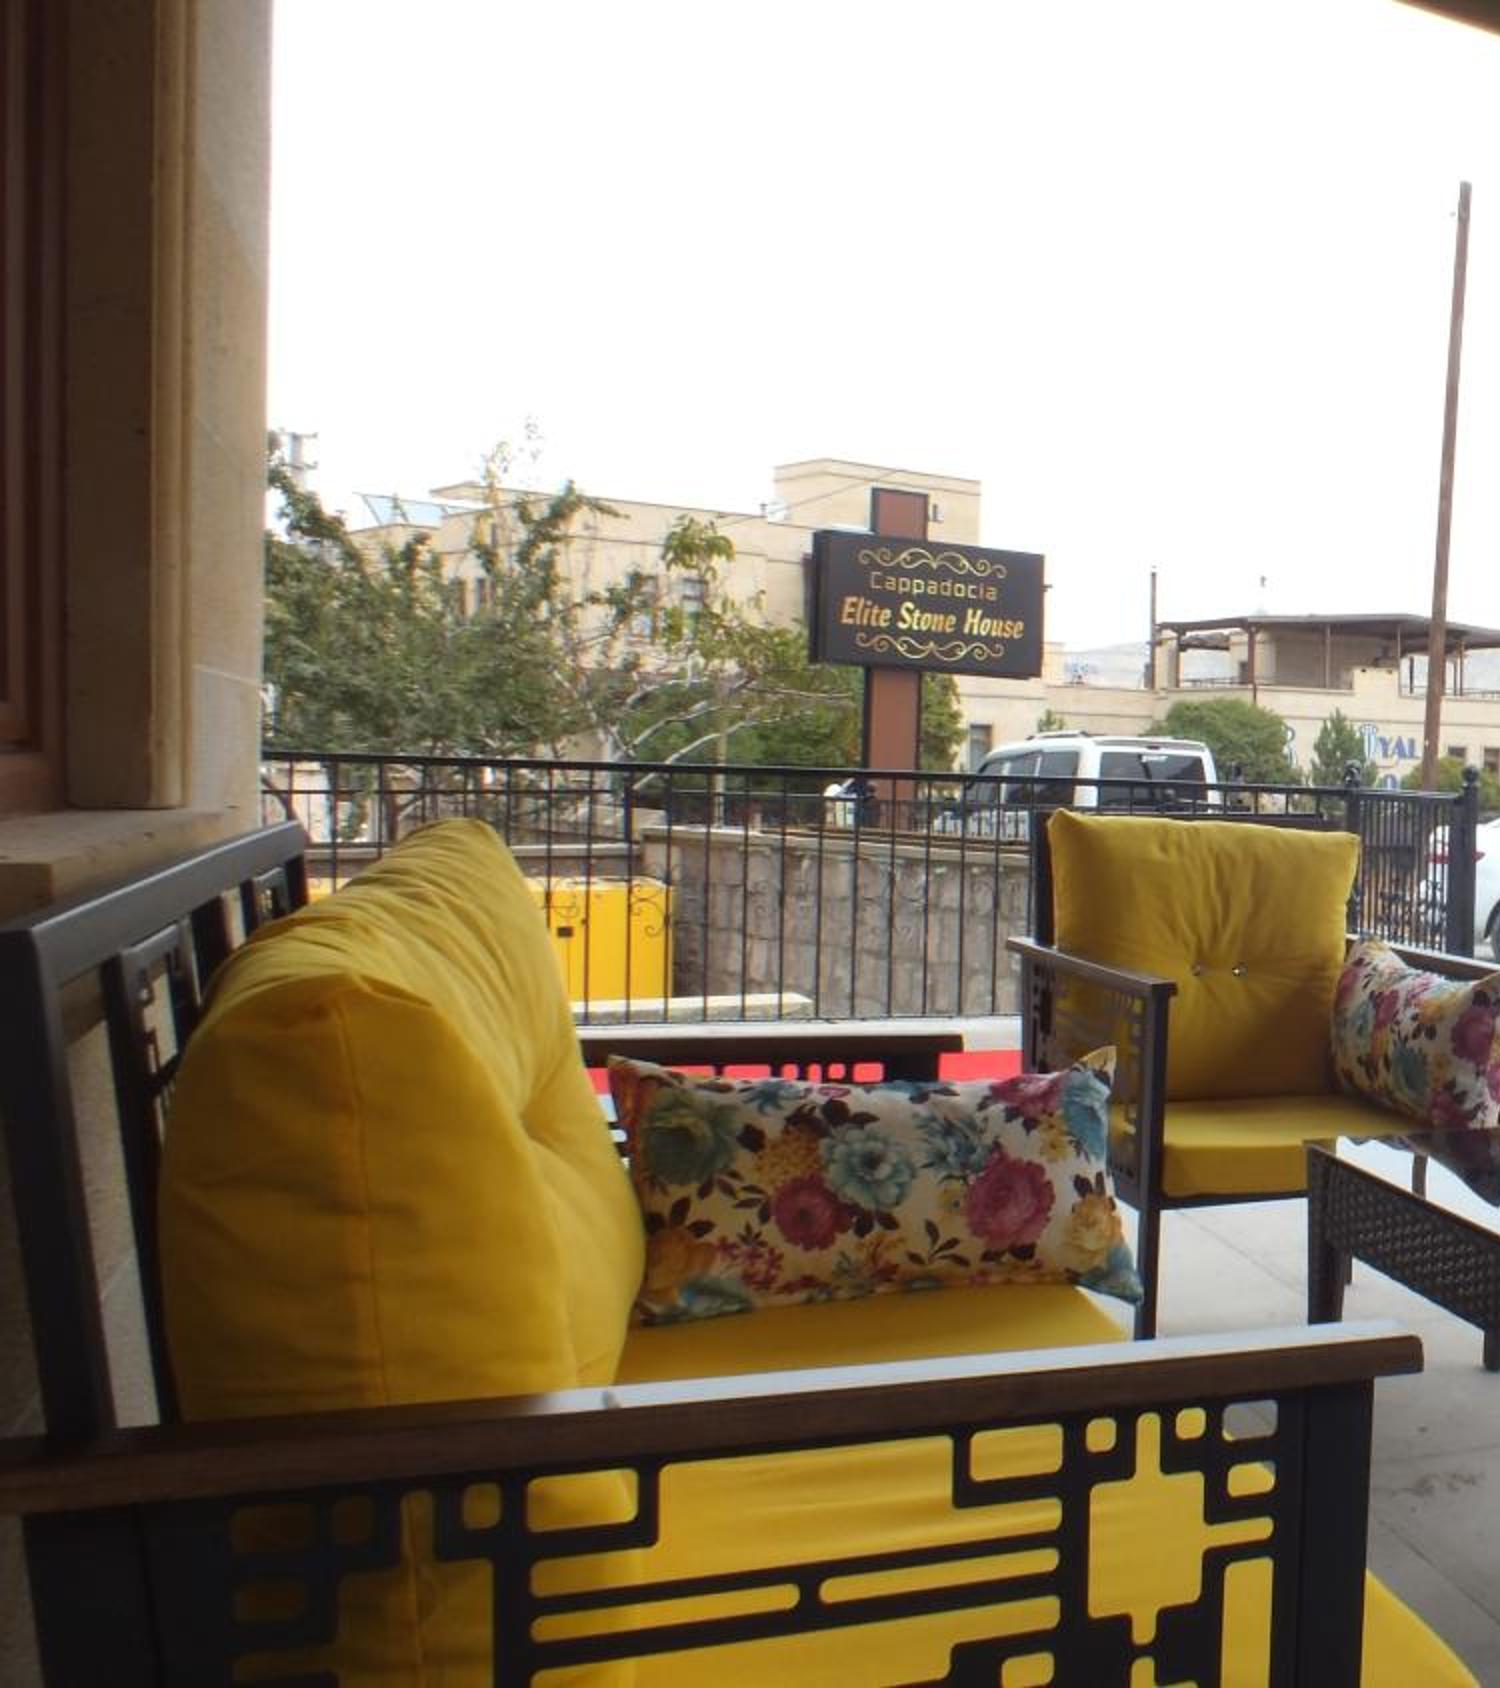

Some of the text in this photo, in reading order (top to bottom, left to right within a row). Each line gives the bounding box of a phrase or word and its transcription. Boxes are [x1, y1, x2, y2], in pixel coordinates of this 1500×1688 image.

[869, 571, 999, 600] Cappadocia
[841, 596, 1025, 639] Elite Stone House
